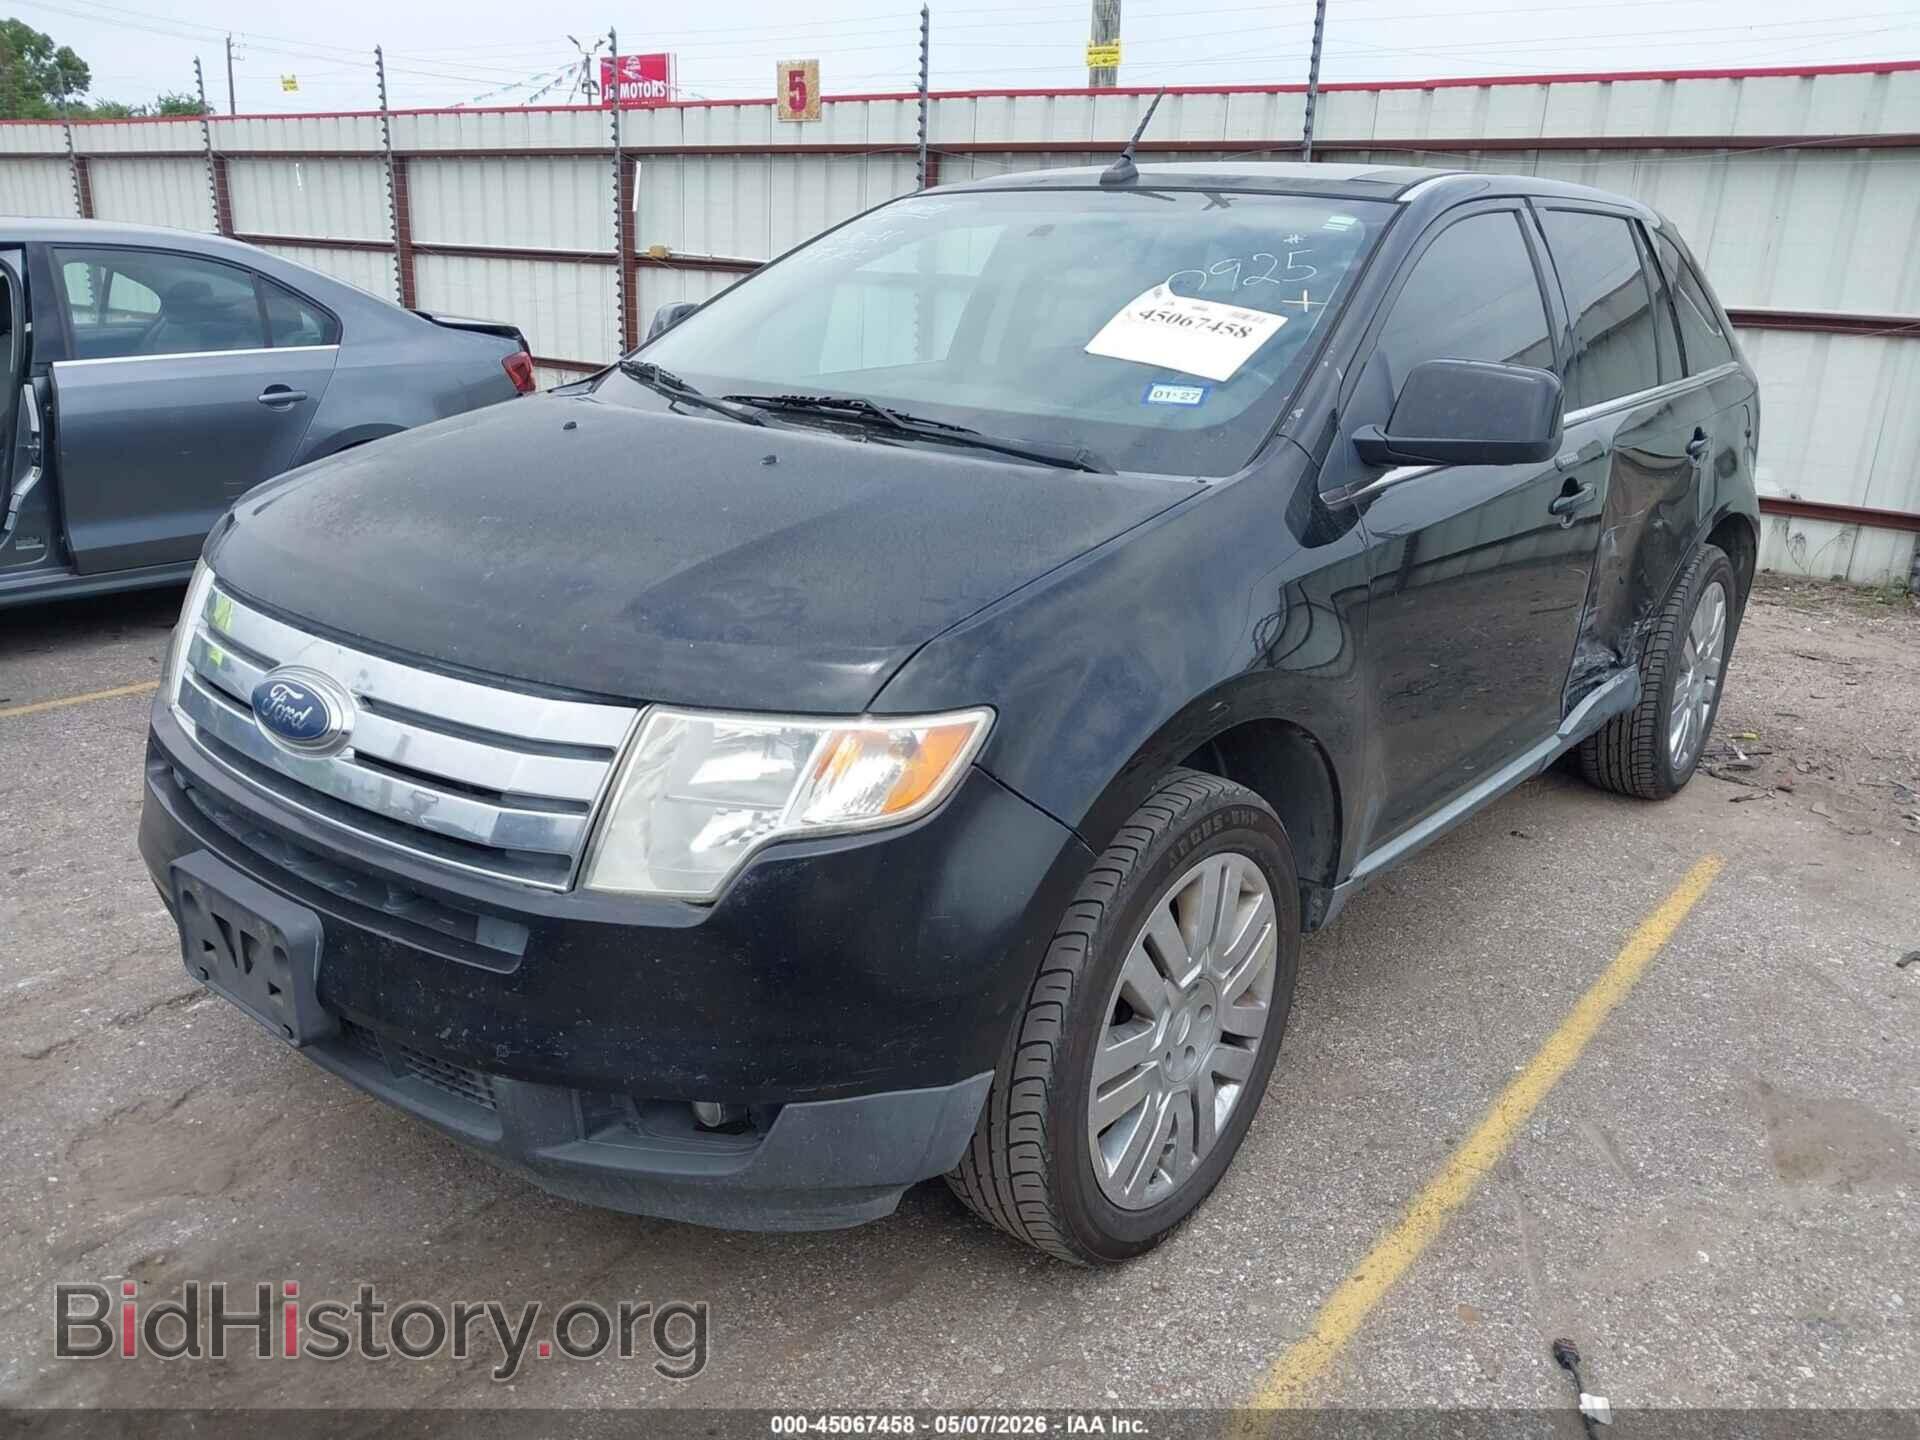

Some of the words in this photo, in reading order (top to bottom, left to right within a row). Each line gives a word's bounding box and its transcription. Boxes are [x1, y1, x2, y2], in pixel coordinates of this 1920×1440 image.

[620, 80, 665, 98] MOTORS
[788, 70, 807, 113] 5
[1139, 308, 1253, 339] 45067458
[261, 683, 313, 729] Ford
